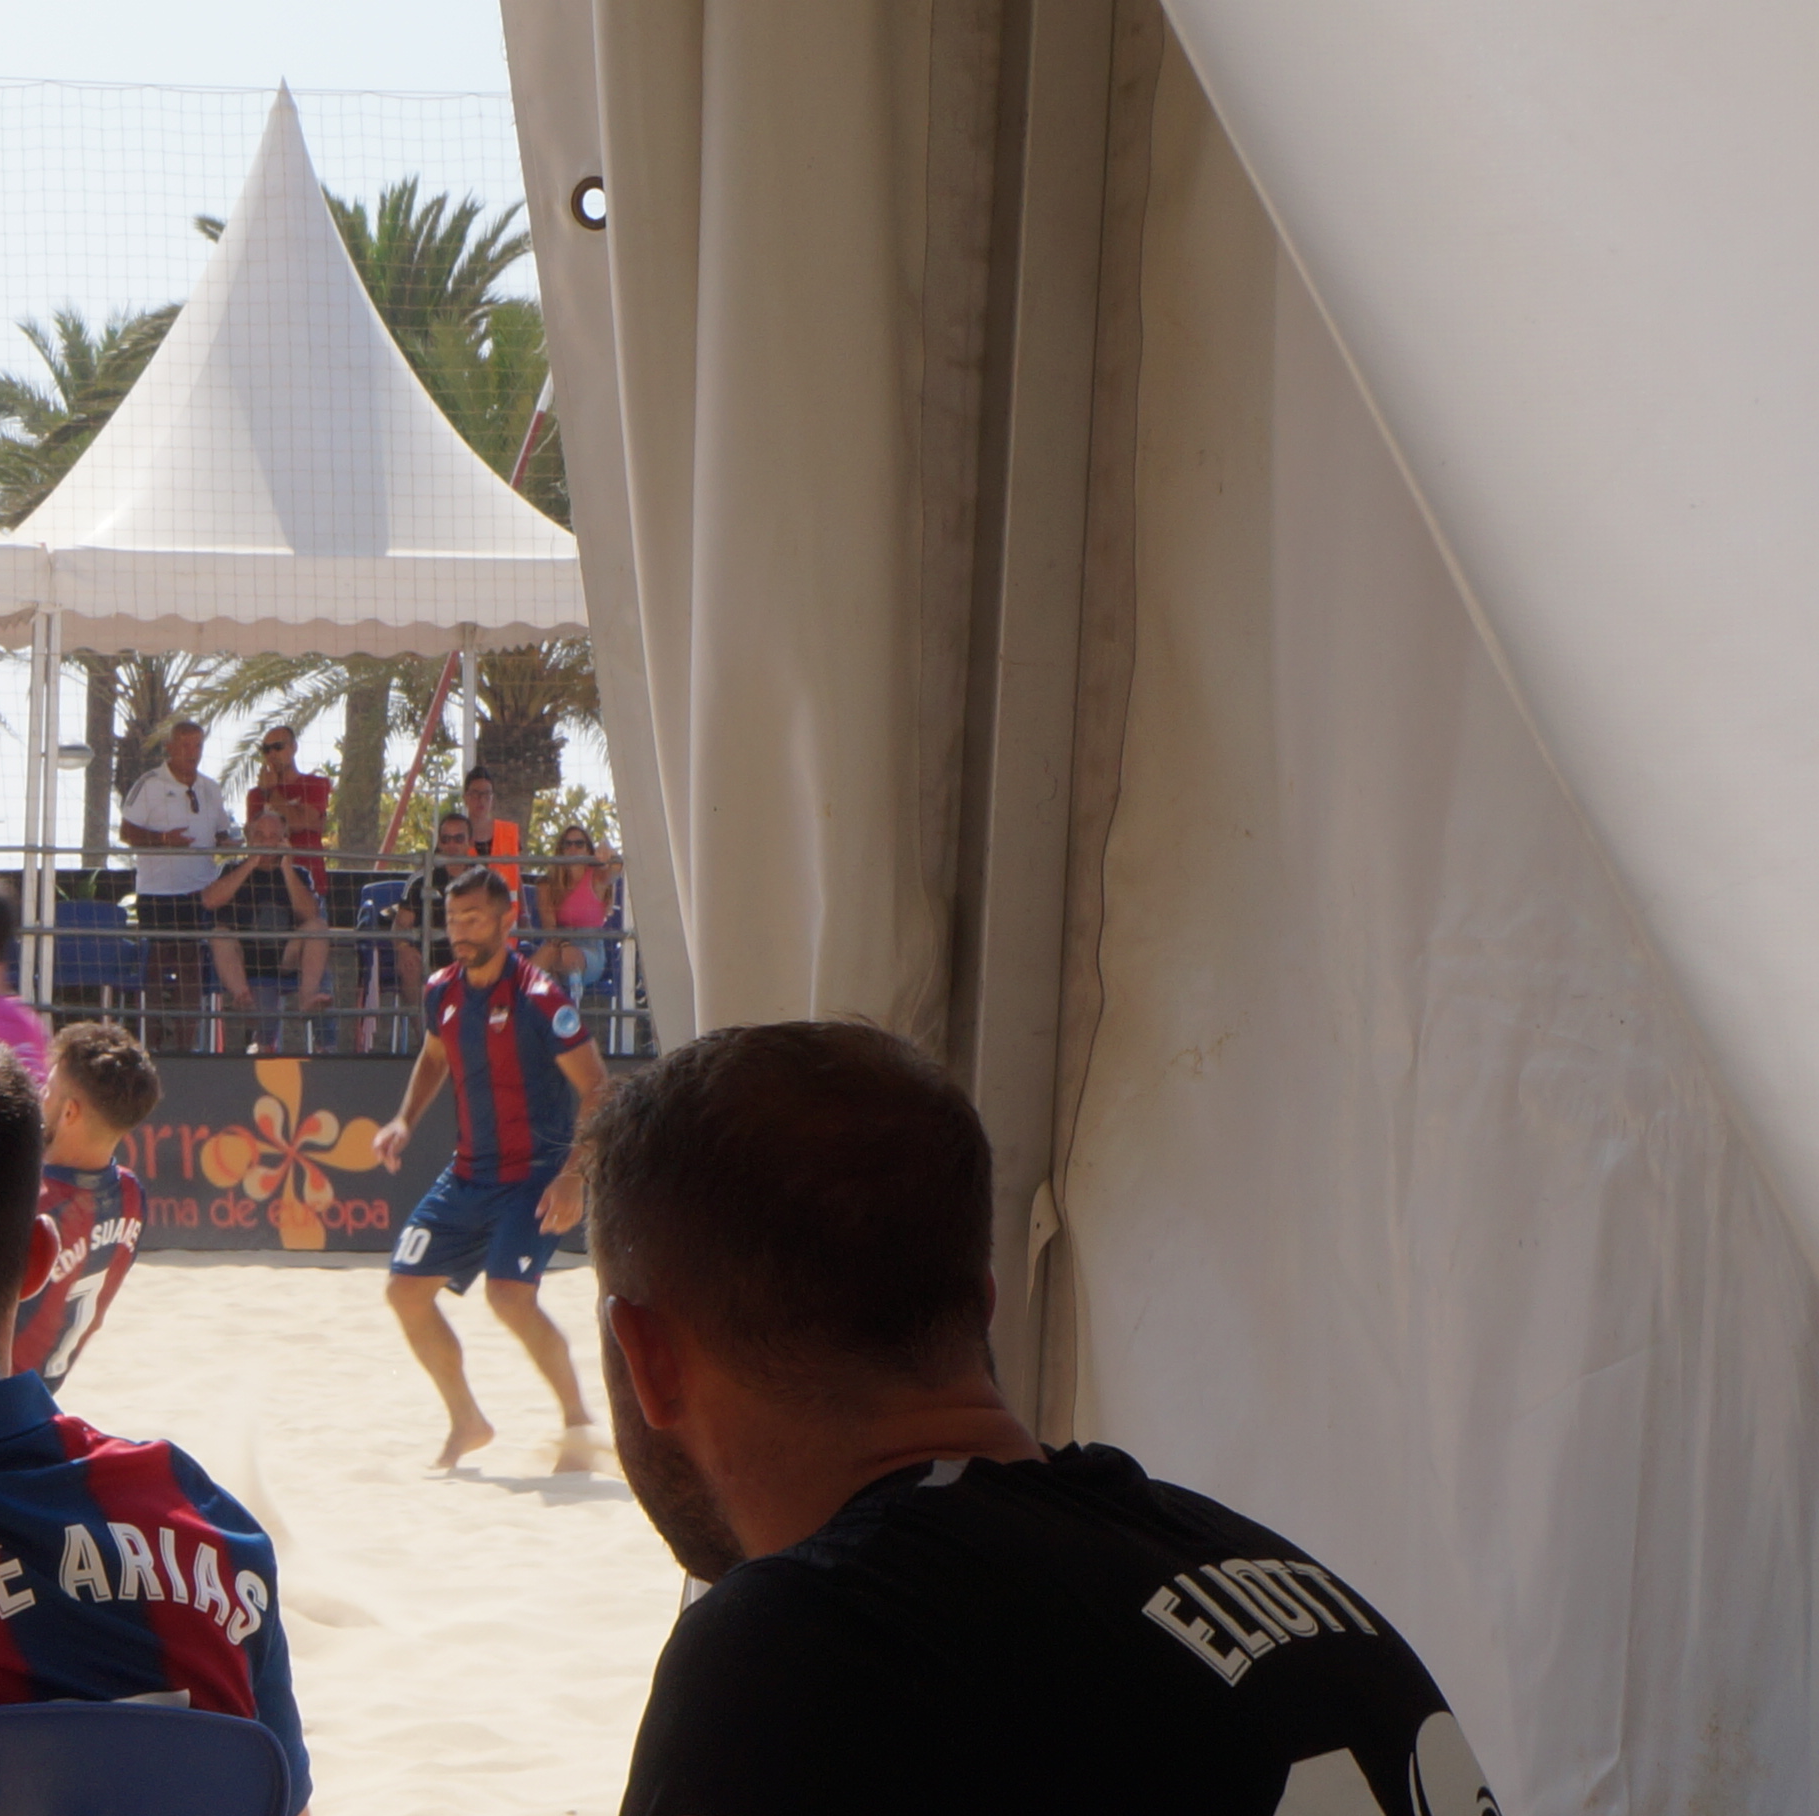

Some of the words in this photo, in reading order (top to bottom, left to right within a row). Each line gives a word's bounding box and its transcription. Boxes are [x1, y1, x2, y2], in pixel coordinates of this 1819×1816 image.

[210, 1192, 258, 1229] de
[393, 1225, 432, 1265] 10
[59, 1521, 268, 1646] ARIAS
